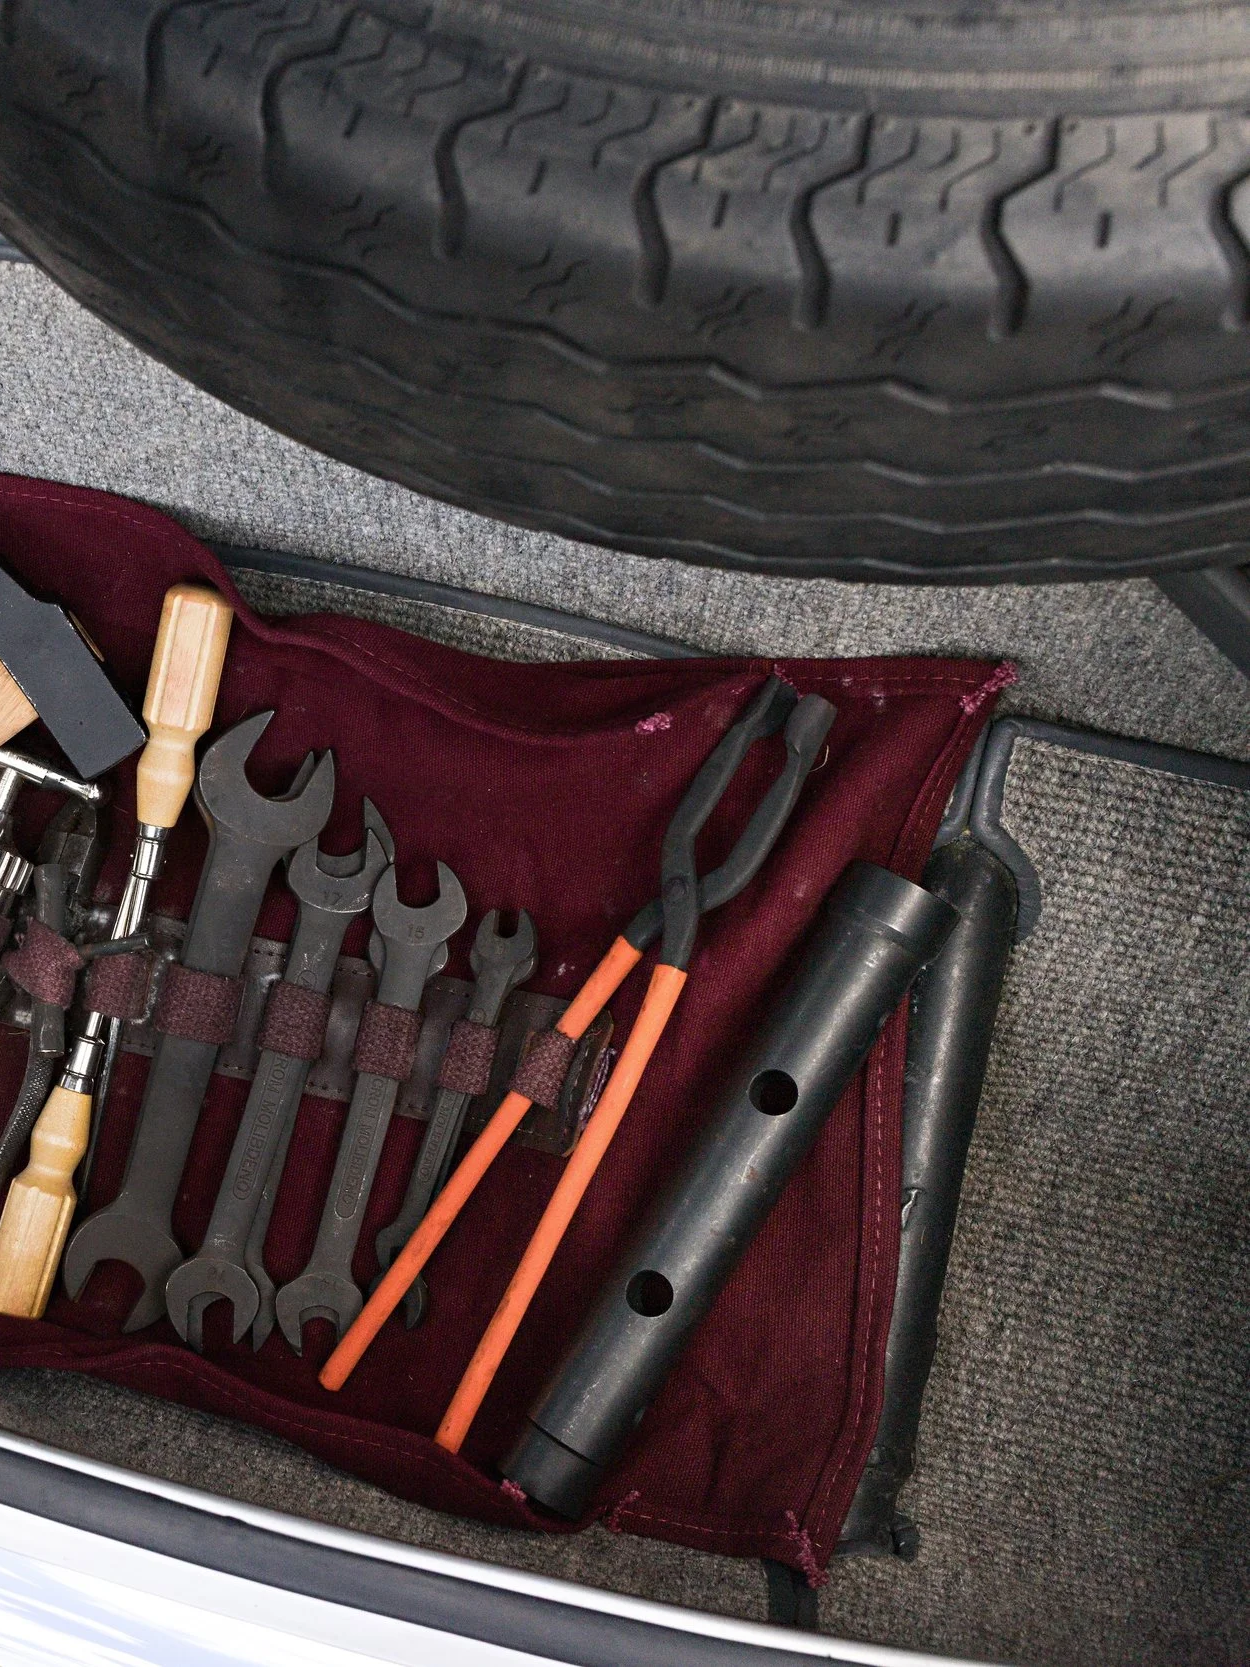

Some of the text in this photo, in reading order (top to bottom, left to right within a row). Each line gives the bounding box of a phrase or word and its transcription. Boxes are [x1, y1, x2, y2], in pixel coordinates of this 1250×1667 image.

[237, 1053, 289, 1192] ROM MOLIBDENO
[343, 1078, 384, 1205] CROM MOLIBDENO
